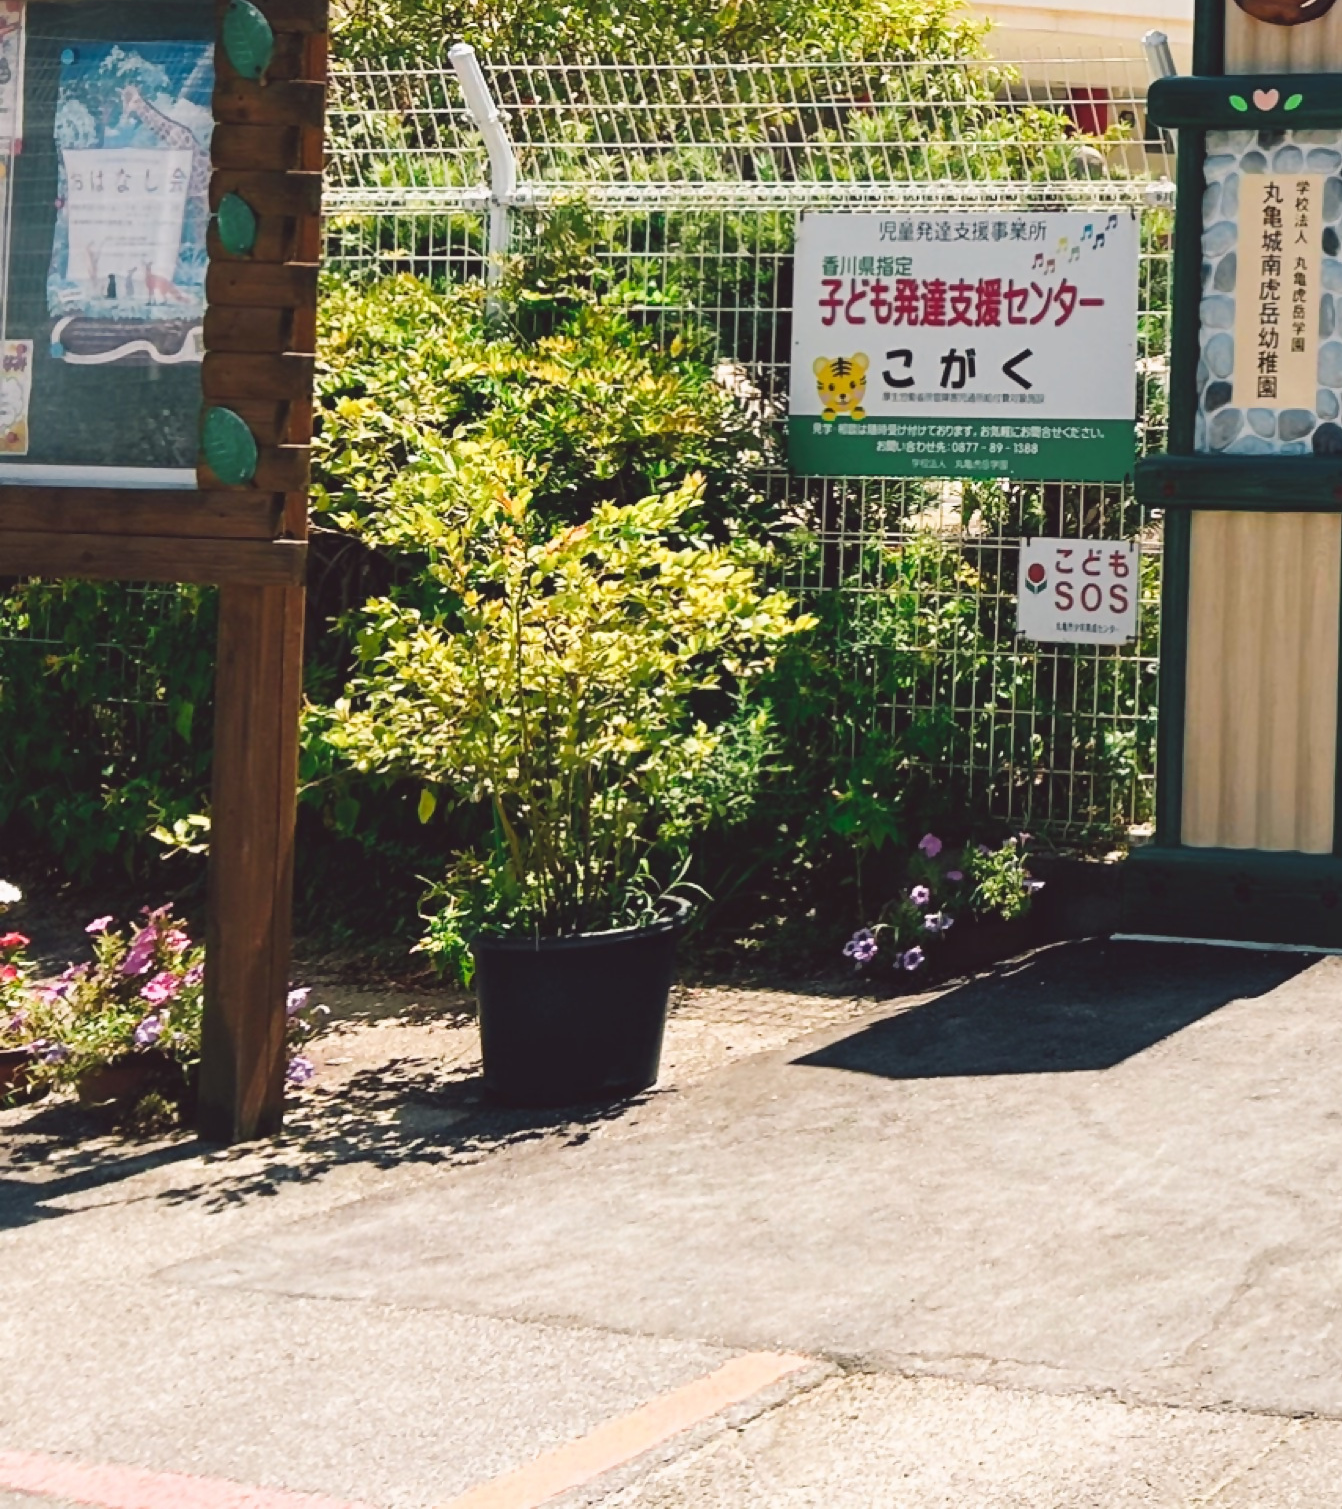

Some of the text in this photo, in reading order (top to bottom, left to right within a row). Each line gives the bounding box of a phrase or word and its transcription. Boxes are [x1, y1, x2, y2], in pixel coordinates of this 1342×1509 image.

[879, 218, 1047, 242] 児童発達支援事業所
[822, 256, 913, 277] 香川県指定
[1291, 180, 1311, 353] 学校法人 丸亀虎岳学園
[818, 278, 1105, 327] 子ども発達支援センター
[1257, 181, 1284, 399] 丸亀城南虎岳幼稚園
[882, 348, 1033, 390] こがく
[1055, 548, 1129, 578] こども
[1054, 581, 1129, 614] SOS
